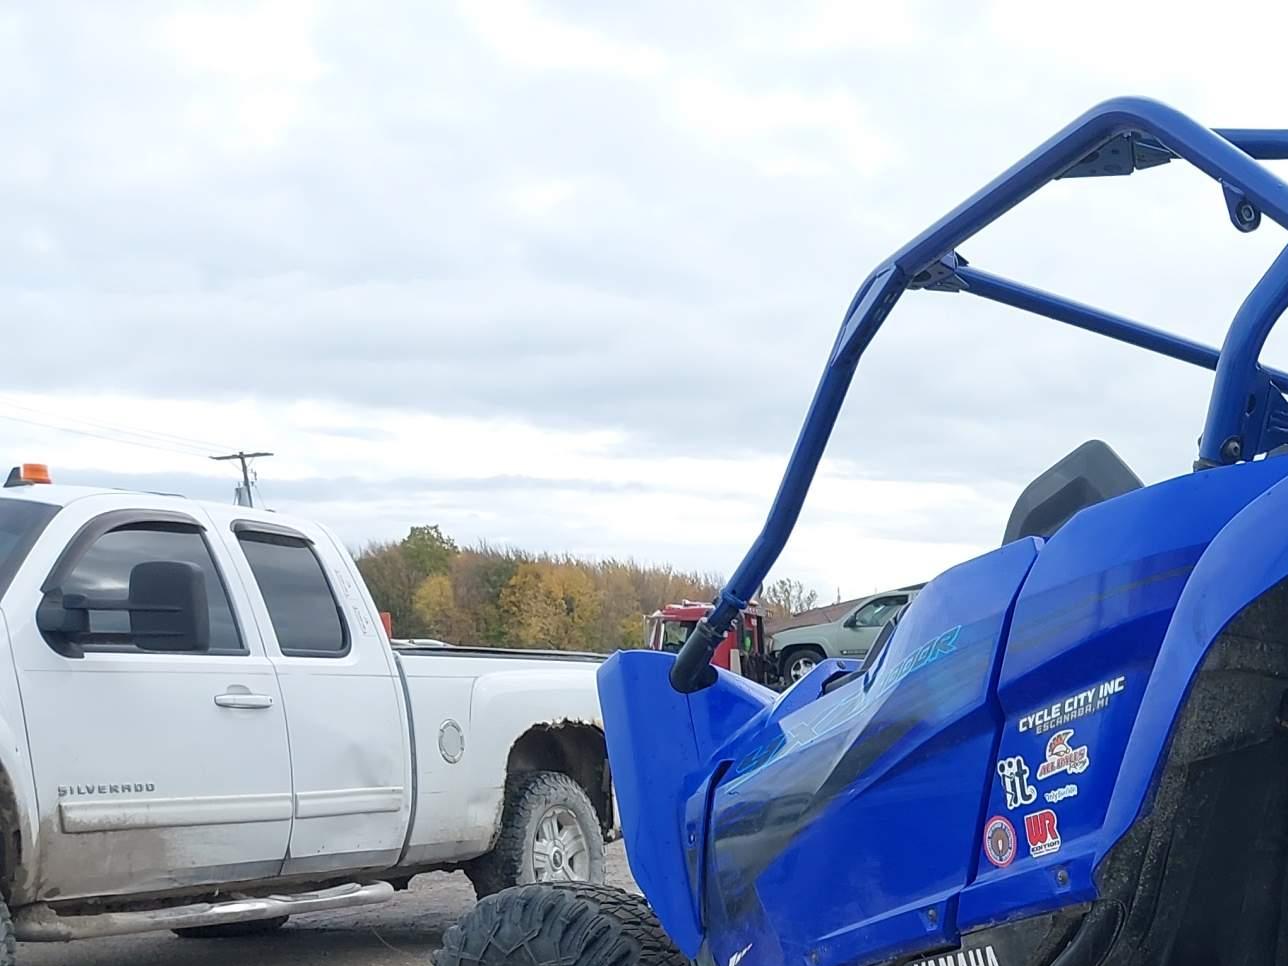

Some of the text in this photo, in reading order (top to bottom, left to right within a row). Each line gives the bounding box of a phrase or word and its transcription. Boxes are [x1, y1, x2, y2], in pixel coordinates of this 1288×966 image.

[1019, 677, 1125, 732] CYCLE CITY INC
[57, 782, 156, 797] SILVERADO
[1025, 811, 1059, 847] WR
